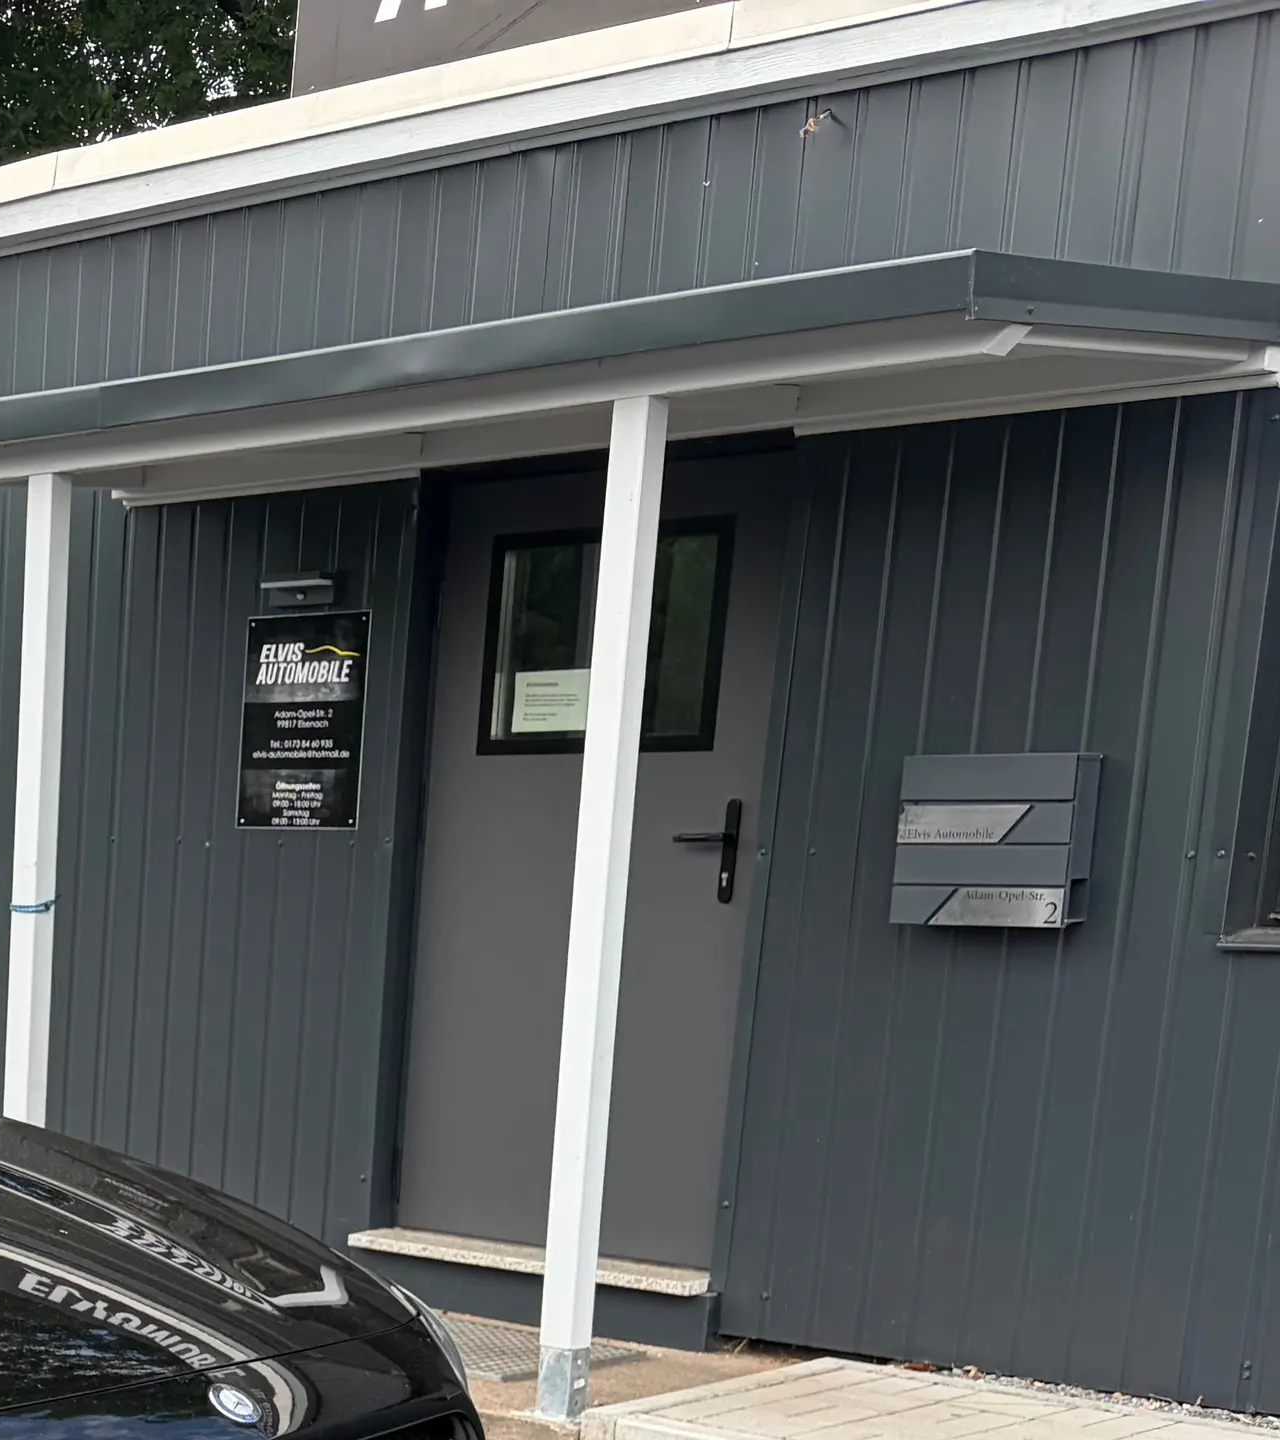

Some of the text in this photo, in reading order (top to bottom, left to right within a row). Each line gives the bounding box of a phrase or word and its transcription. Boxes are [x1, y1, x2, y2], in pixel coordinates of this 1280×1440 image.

[259, 642, 305, 663] ELVIS
[255, 660, 353, 685] AUTOMOBILE
[907, 827, 994, 840] Elvis Automobile
[1042, 901, 1058, 924] 2
